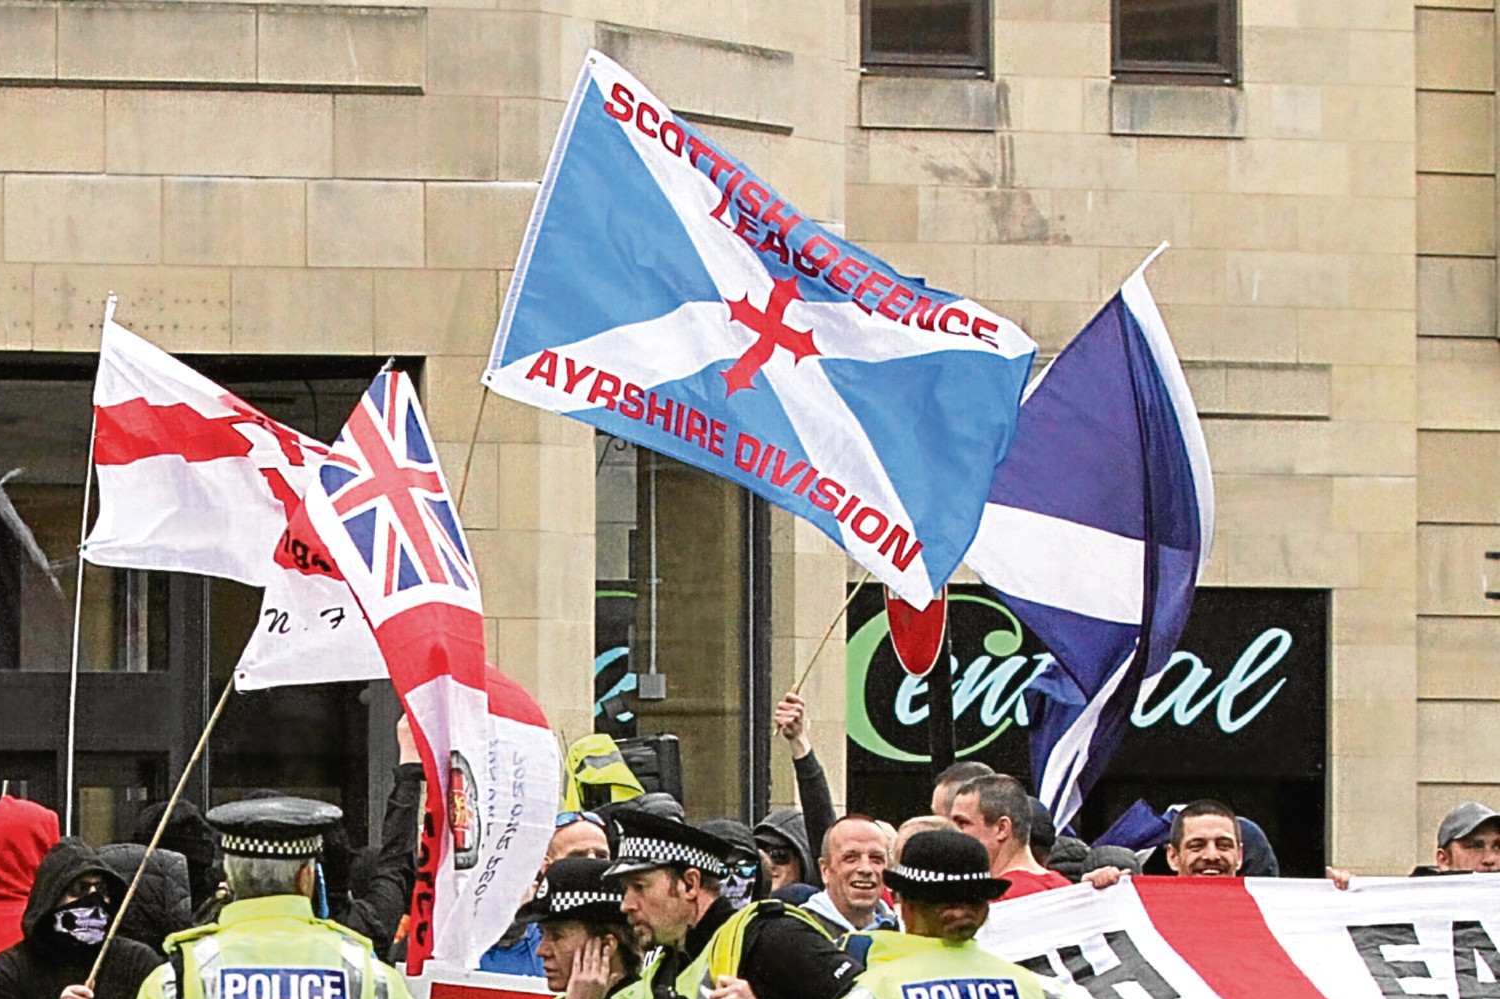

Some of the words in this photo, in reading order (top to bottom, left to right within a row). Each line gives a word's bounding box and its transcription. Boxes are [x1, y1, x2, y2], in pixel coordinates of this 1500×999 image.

[603, 82, 803, 239] SCOTTISH
[801, 234, 1000, 350] DEFENCE
[709, 194, 874, 317] LEAG
[524, 349, 728, 457] AYRSHIRE
[734, 432, 924, 573] DIVISION
